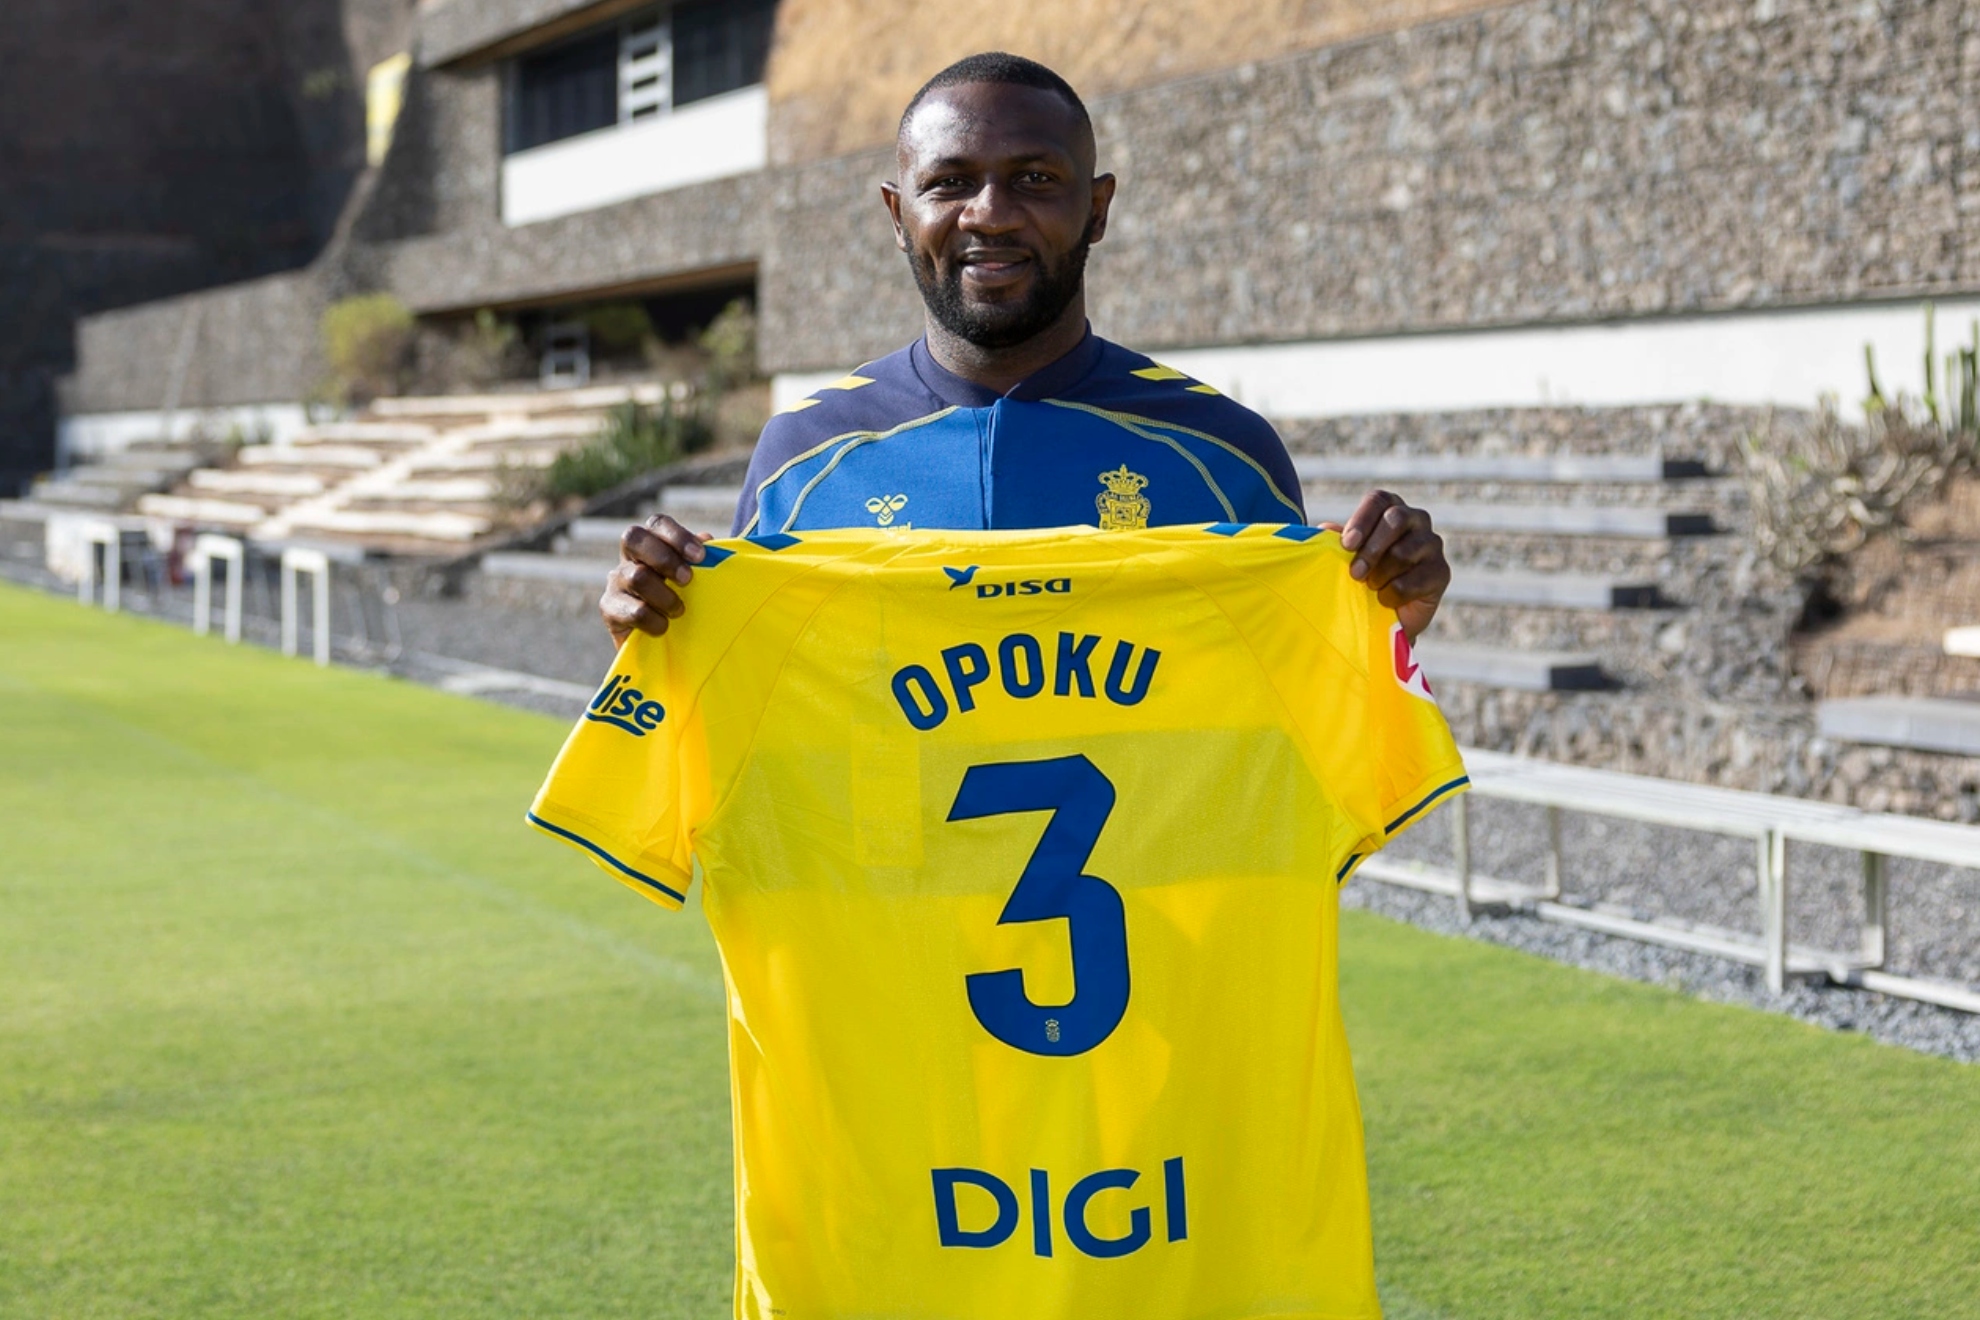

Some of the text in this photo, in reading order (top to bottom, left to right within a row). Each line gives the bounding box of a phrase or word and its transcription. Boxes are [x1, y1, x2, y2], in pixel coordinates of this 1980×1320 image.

[891, 631, 1161, 731] OPOKU
[945, 753, 1131, 1057] 3
[931, 1156, 1188, 1258] DIGI
